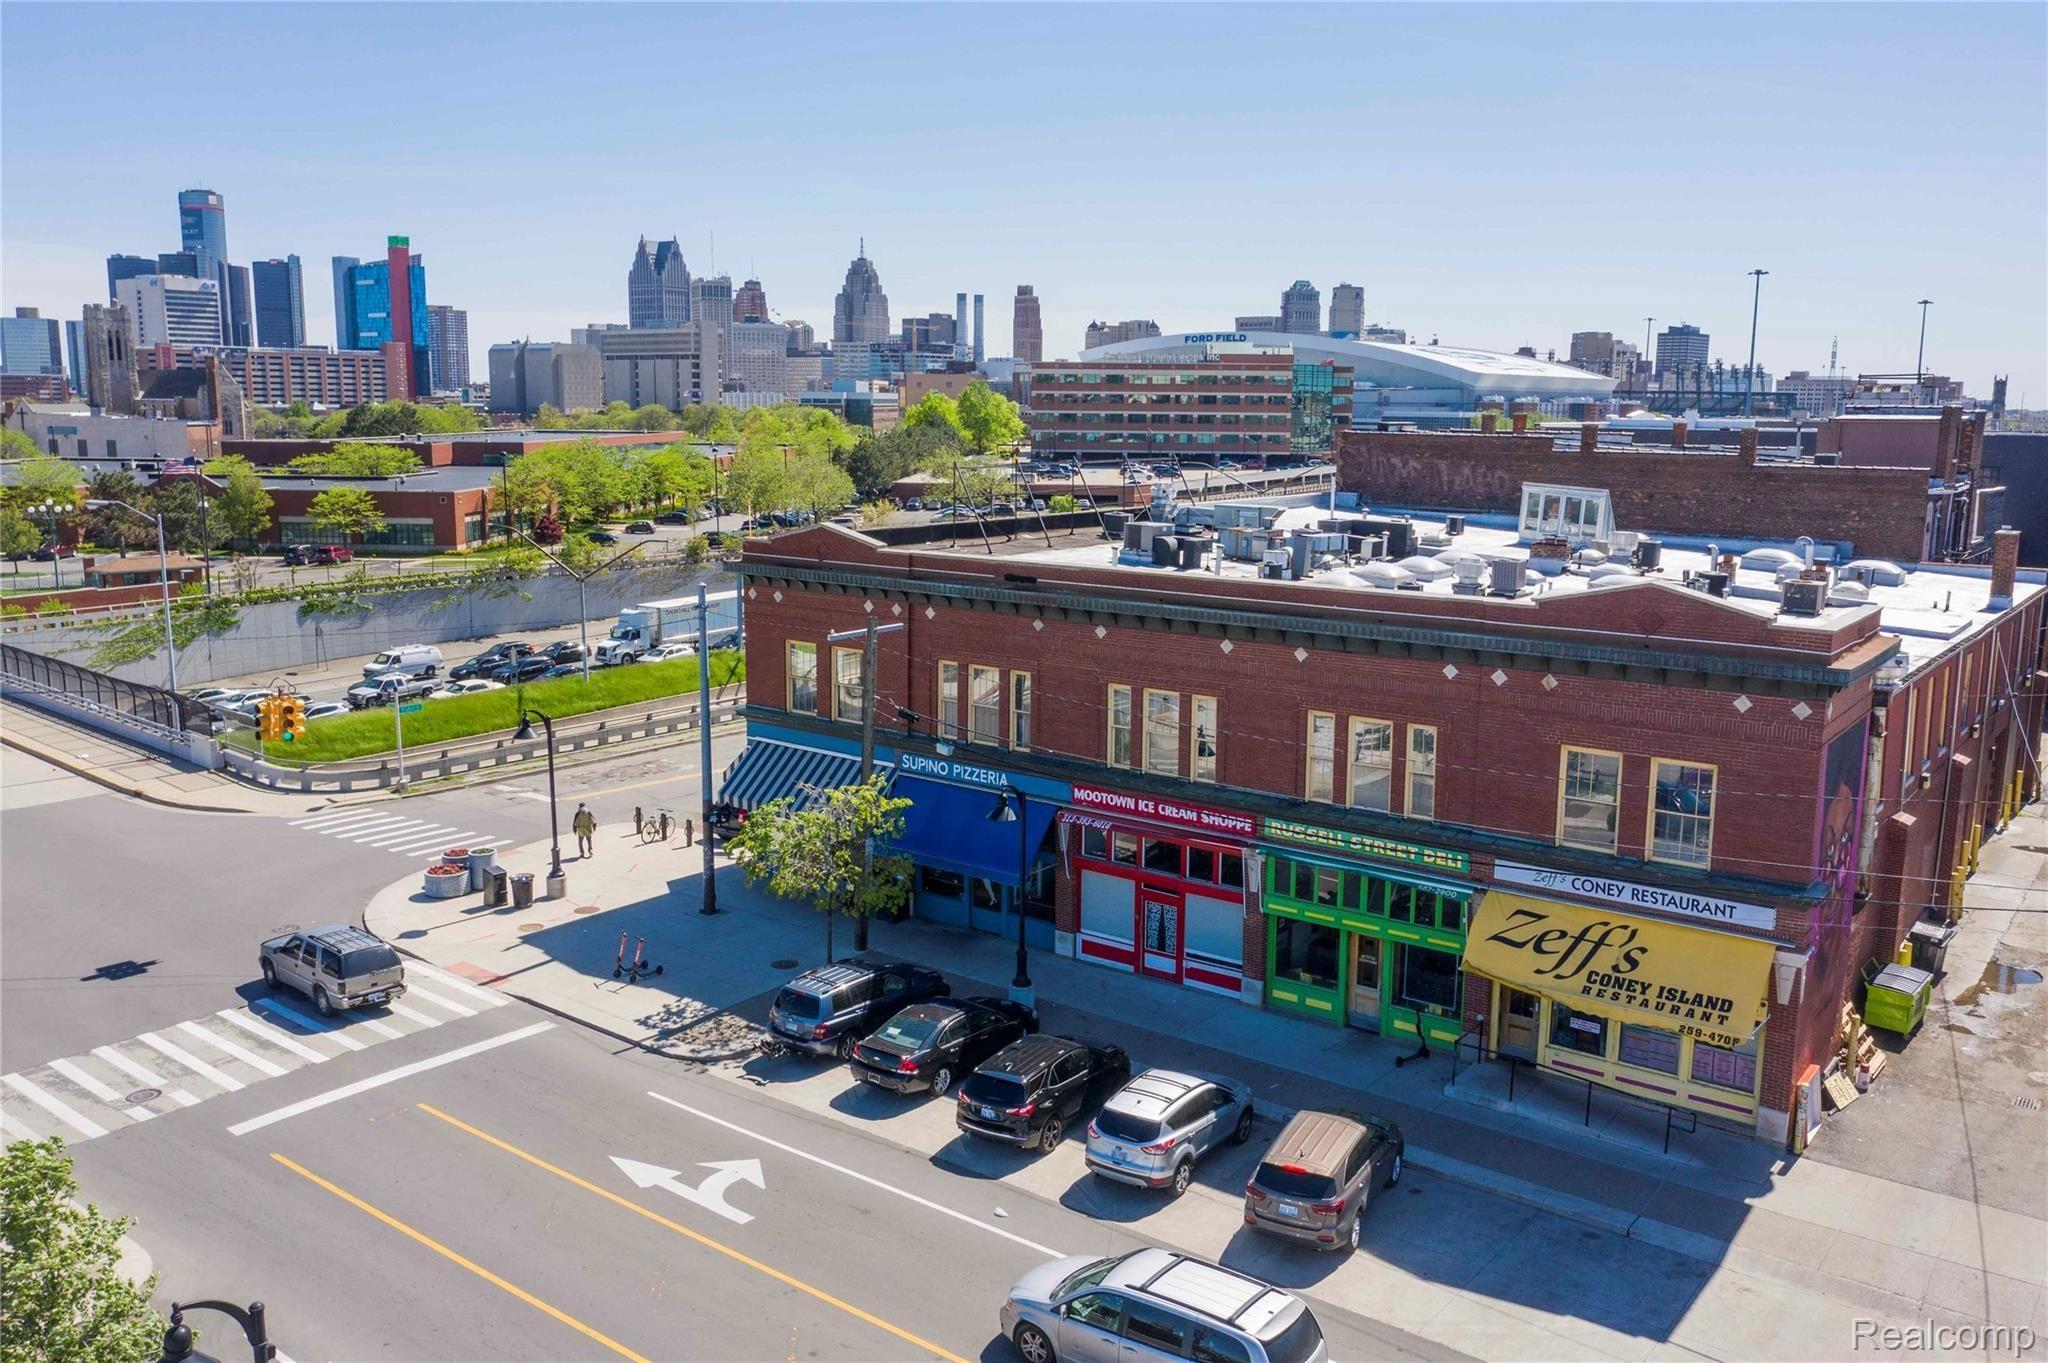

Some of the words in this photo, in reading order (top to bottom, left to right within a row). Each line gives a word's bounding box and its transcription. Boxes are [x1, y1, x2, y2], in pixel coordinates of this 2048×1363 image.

[1184, 334, 1213, 344] FORD
[1216, 334, 1247, 342] FIELD
[902, 754, 949, 776] SUPINO
[953, 764, 1008, 786] PIZZERIA
[1073, 788, 1136, 810] MOOTOWN
[1138, 799, 1155, 814] ICE
[1158, 804, 1197, 822] CREAM
[1200, 810, 1252, 832] SHOPPE
[1270, 821, 1345, 847] RUSSELL
[1349, 836, 1418, 860] STREET
[1423, 849, 1462, 868] DELI
[1533, 871, 1567, 888] Zeff's
[1571, 877, 1625, 898] CONEY
[1631, 889, 1737, 919] RESTAURANT
[1485, 909, 1648, 980] Zeff's
[1581, 985, 1731, 1026] RESTAURANT
[1586, 970, 1653, 996] CONEY
[1656, 985, 1735, 1014] ISLAND
